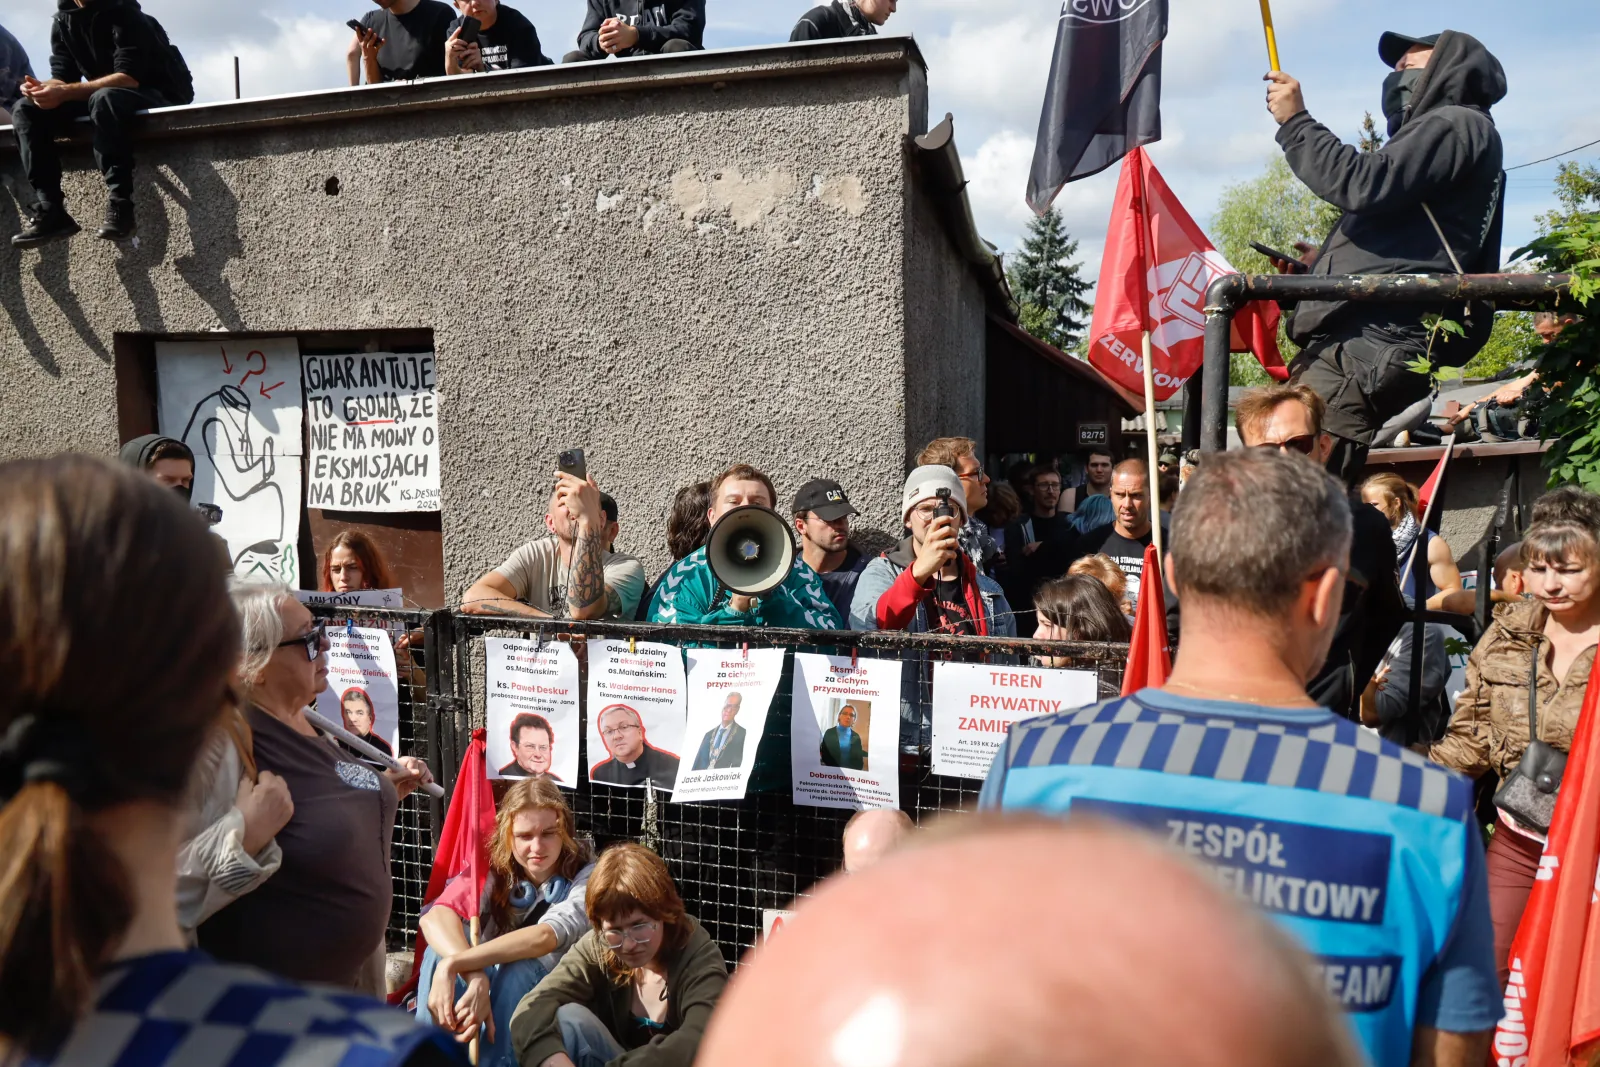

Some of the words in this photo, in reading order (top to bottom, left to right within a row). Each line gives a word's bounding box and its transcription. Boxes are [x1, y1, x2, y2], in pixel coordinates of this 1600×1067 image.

[309, 395, 333, 421] TO
[343, 392, 407, 424] GŁOWĄ,
[410, 392, 434, 418] ŻE
[311, 424, 338, 450] NIE
[343, 428, 366, 449] MA
[371, 426, 417, 448] MOWY
[423, 427, 434, 446] O
[315, 454, 428, 480] EKSMISJACH
[310, 482, 334, 505] NA
[400, 490, 415, 500] KS.
[826, 490, 843, 501] CAT
[417, 501, 437, 509] 2024
[328, 631, 380, 642] Odpowiedzialny
[341, 643, 370, 652] eksmisję
[503, 644, 559, 656] Odpowiedzialny
[516, 656, 547, 665] eksmisję
[620, 658, 654, 668] eksmisję
[331, 666, 360, 676] Zbigniew
[362, 669, 392, 678] Zieliński
[728, 670, 756, 680] cichym
[830, 666, 868, 676] Eksmisje
[837, 676, 869, 686] cichym
[990, 672, 1042, 688] TEREN
[511, 682, 535, 692] Paweł
[537, 686, 568, 695] Deskur
[610, 682, 649, 692] Waldemar
[651, 686, 676, 694] Hanas
[813, 685, 880, 697] przyzwoleniem:
[624, 694, 673, 704] Archidiecezjalny
[970, 695, 1061, 713] PRYWATNY
[958, 717, 1015, 734] ZAMIE
[682, 775, 702, 783] Jacek
[703, 772, 741, 782] Jaśkowiak
[809, 772, 855, 782] Dobrosława
[857, 777, 879, 786] Janas
[1166, 820, 1287, 868] ZESPÓŁ
